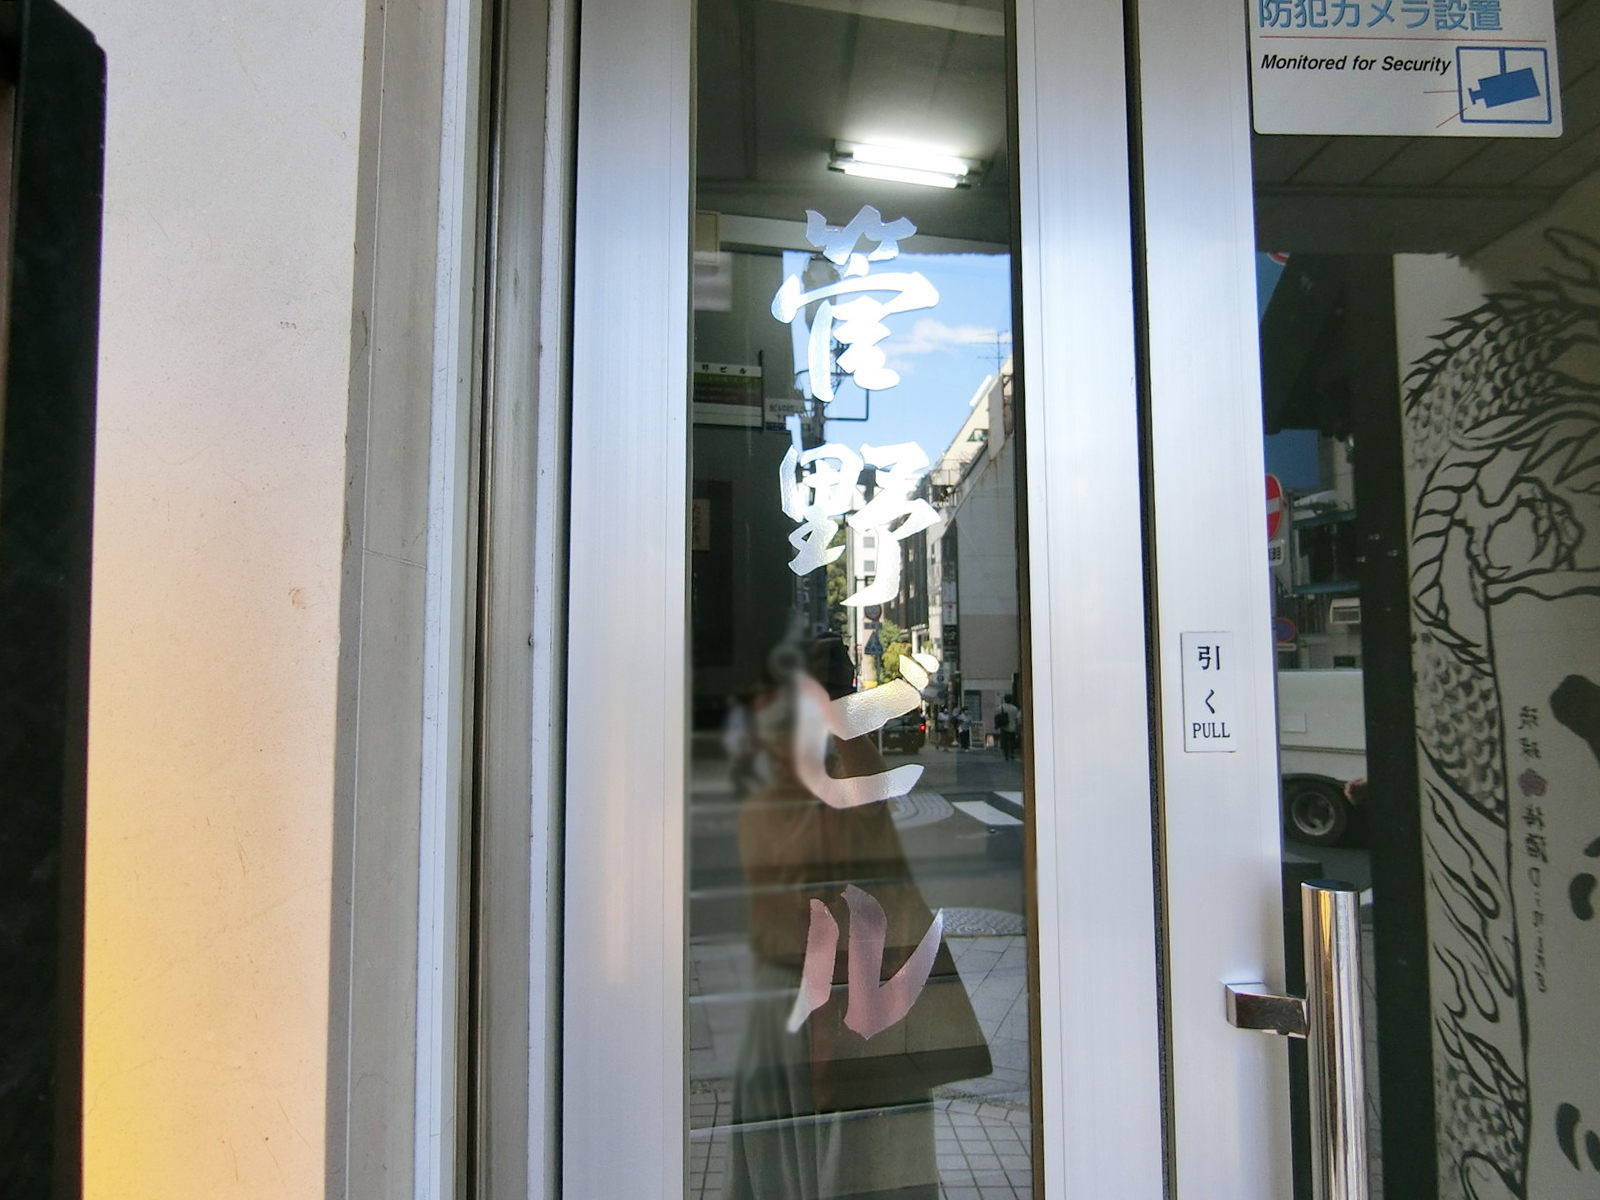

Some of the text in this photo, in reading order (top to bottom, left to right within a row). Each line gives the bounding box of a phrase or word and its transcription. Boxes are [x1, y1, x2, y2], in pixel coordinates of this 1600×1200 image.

[1259, 0, 1502, 31] 防犯カメラ設置
[1260, 54, 1451, 75] Monitored for Security
[1197, 645, 1220, 714] 引く
[1192, 722, 1231, 739] PULL
